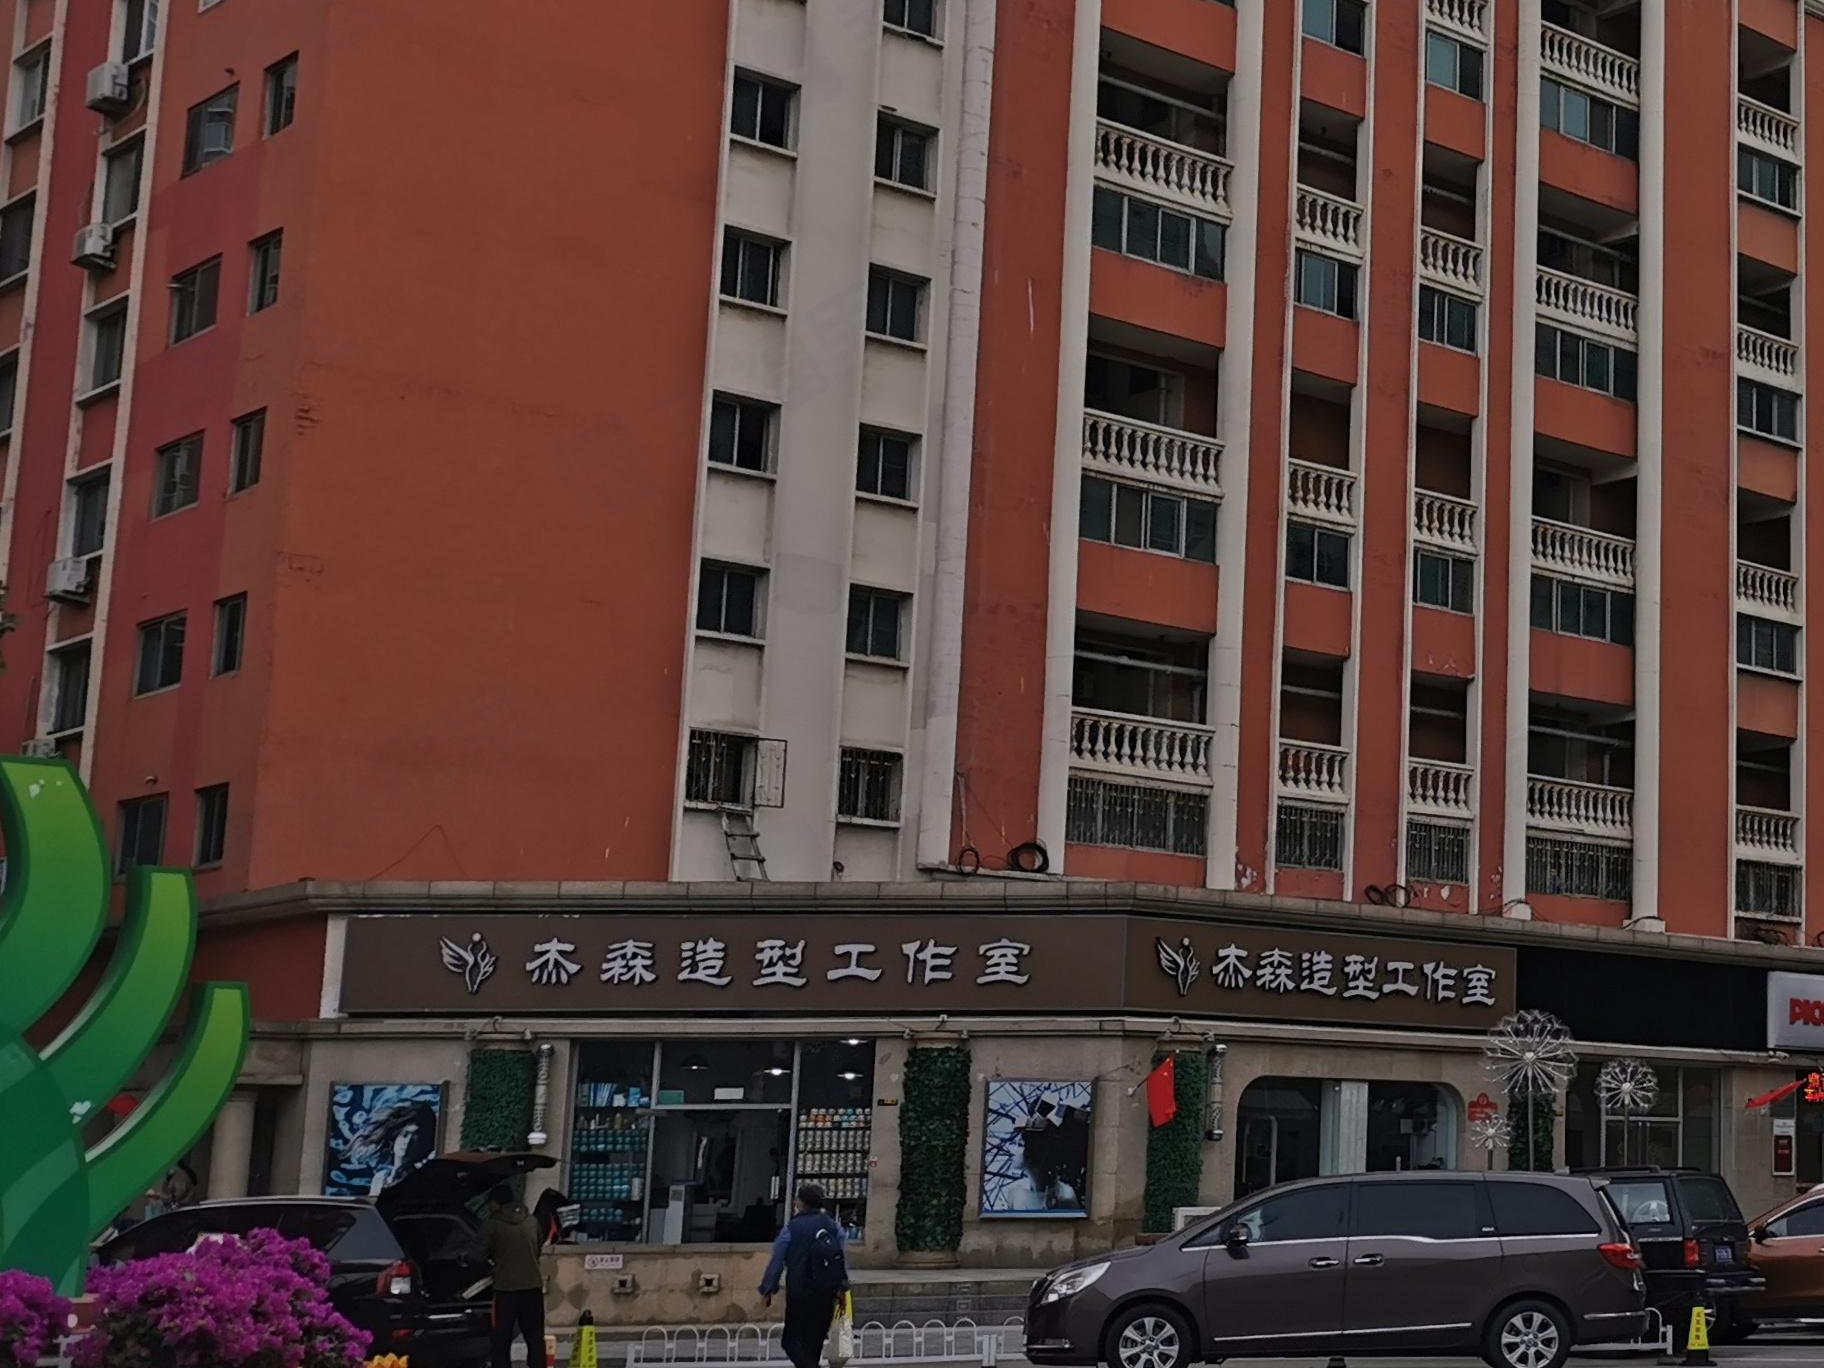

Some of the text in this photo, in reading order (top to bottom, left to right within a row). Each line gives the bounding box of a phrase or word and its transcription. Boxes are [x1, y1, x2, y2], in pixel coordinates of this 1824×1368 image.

[525, 937, 1032, 986] 杰森造型工作室
[1212, 943, 1496, 1006] 杰森造型工作室
